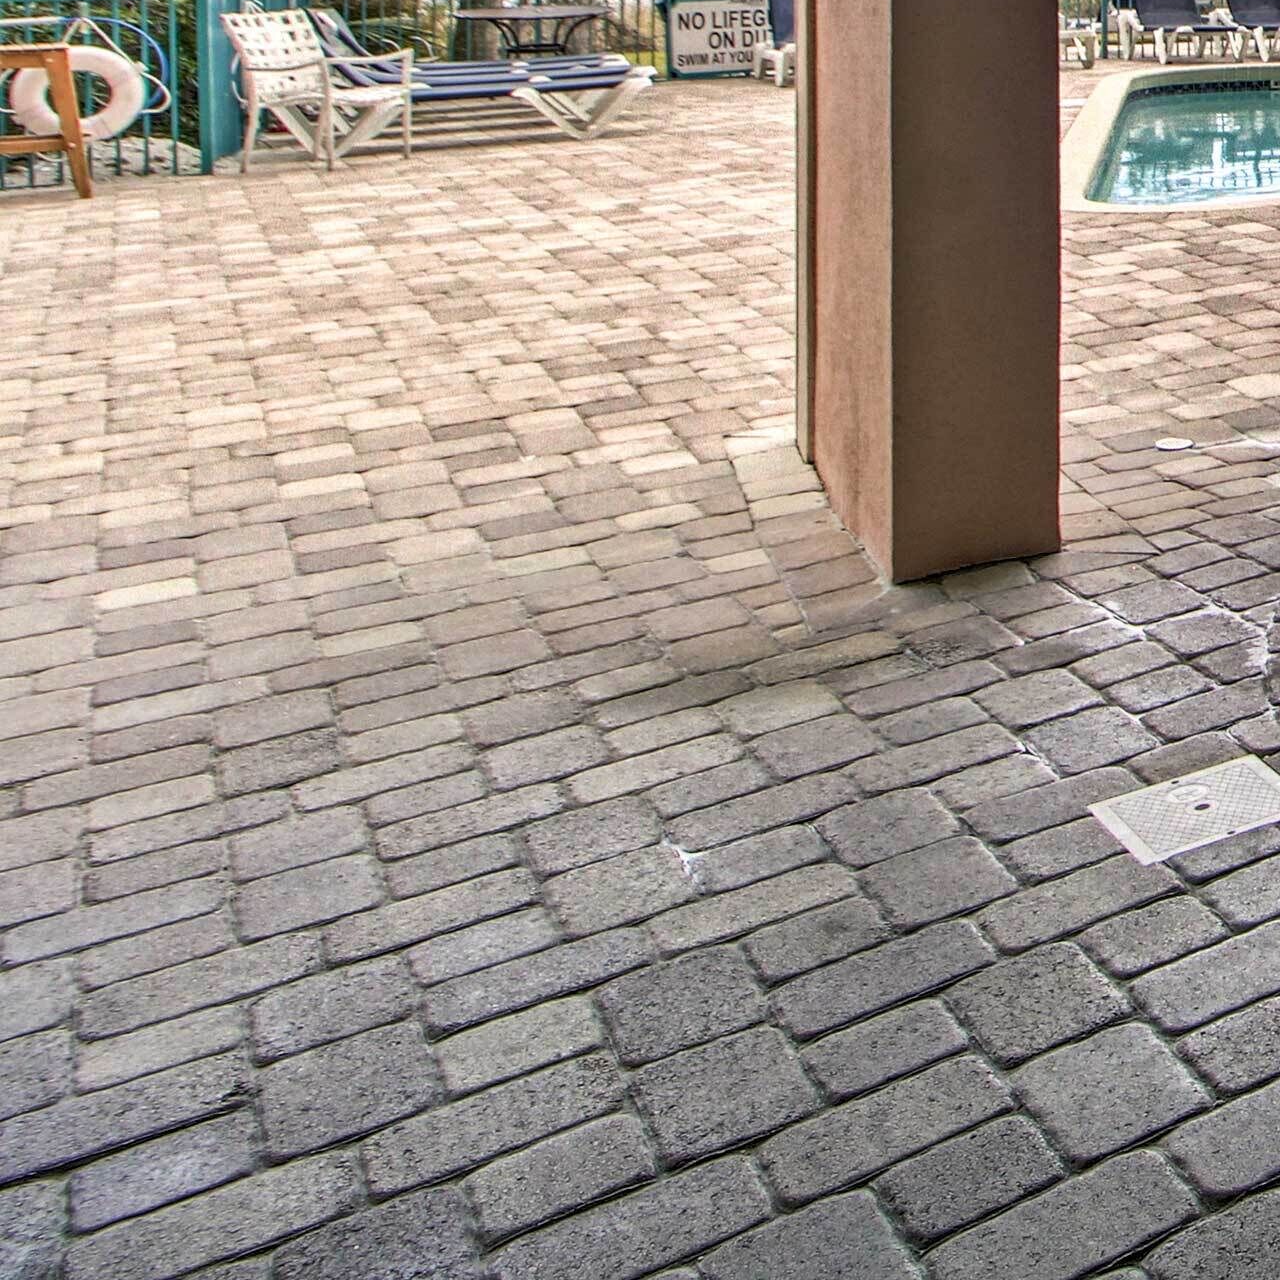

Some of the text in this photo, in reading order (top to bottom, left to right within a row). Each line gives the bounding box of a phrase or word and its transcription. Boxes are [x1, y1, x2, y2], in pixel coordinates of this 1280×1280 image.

[677, 9, 766, 31] NO LIFEG
[708, 30, 767, 49] ON DU
[677, 50, 754, 67] SWIM AT YOU
